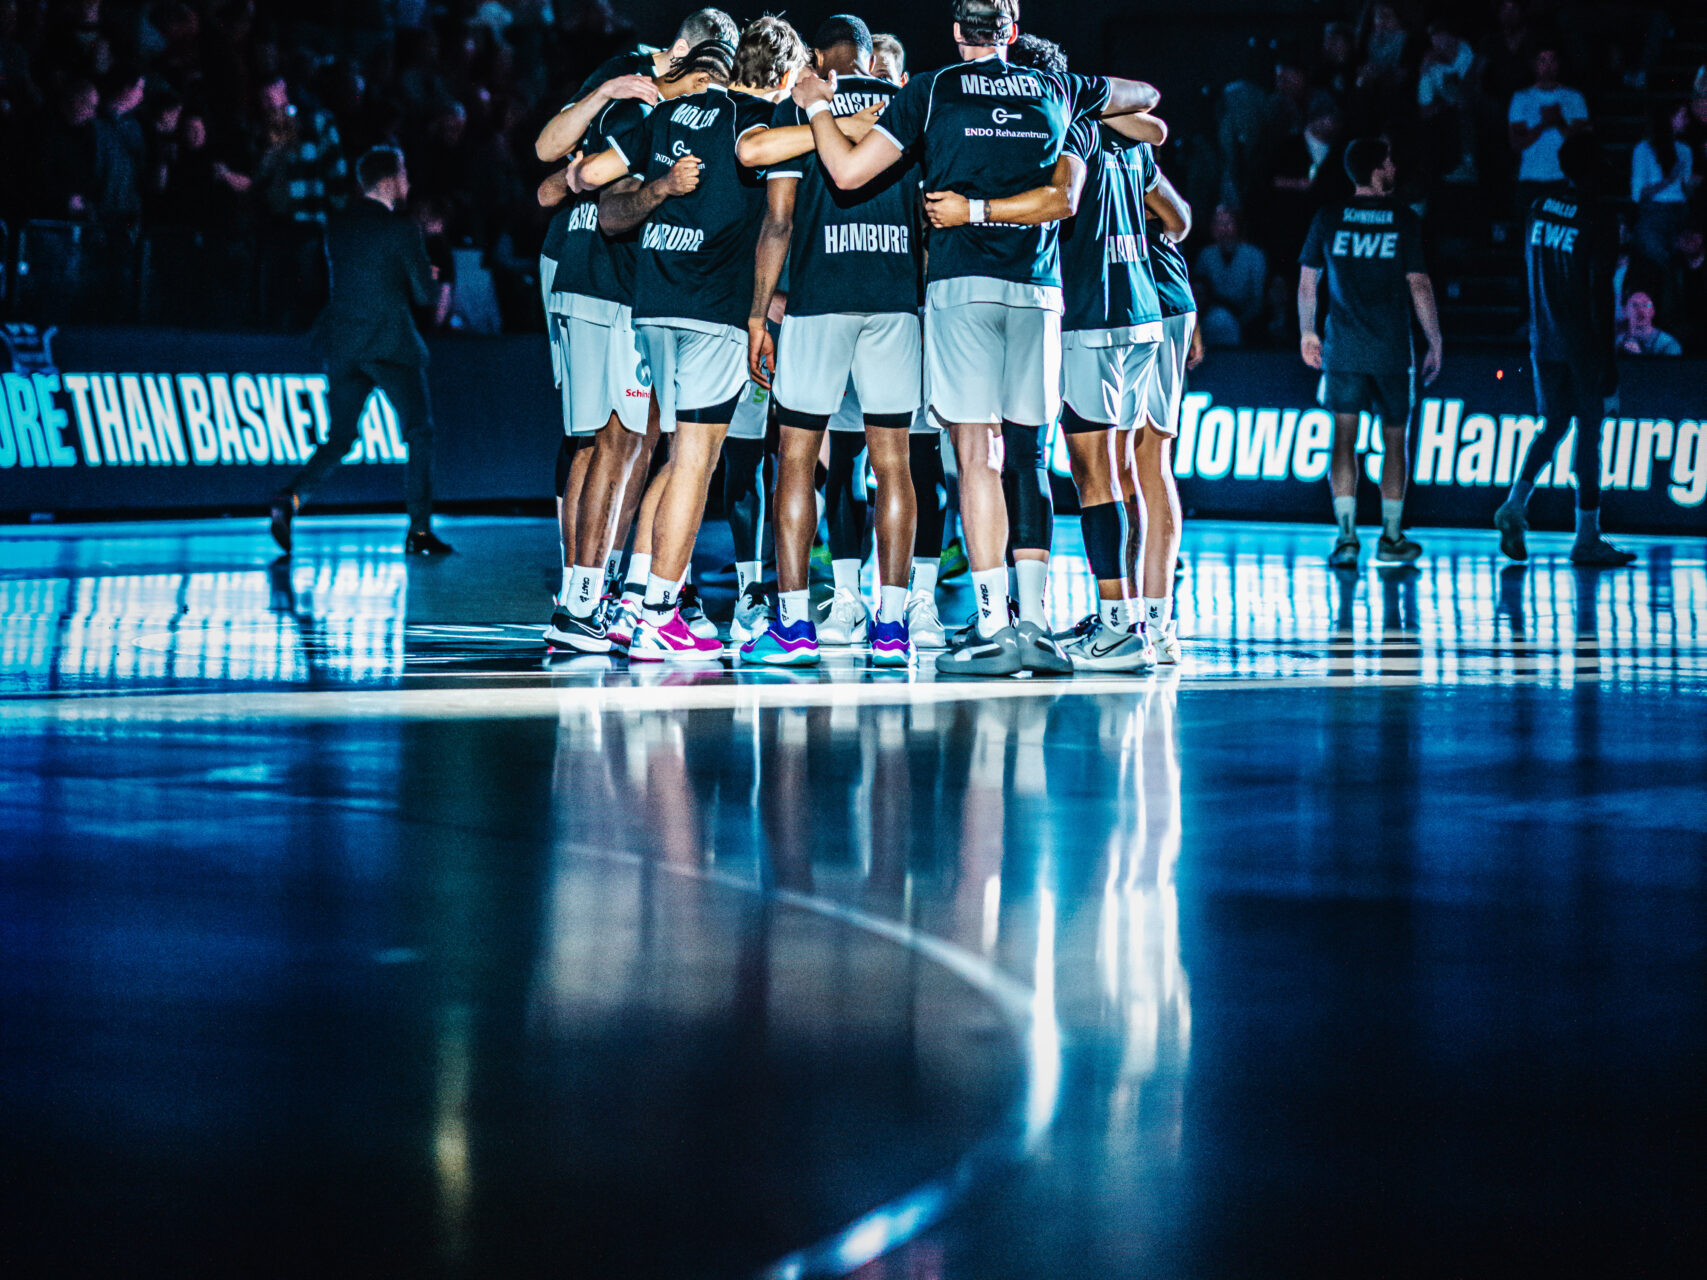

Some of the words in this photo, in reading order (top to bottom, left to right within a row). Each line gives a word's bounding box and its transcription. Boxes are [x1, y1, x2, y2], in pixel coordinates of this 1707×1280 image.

[964, 127, 994, 137] ENDO
[995, 128, 1049, 139] Rehazentrum
[824, 223, 909, 254] HAMBURG
[1332, 230, 1399, 259] EWE
[1531, 219, 1579, 254] EWE
[62, 373, 188, 465] THAN
